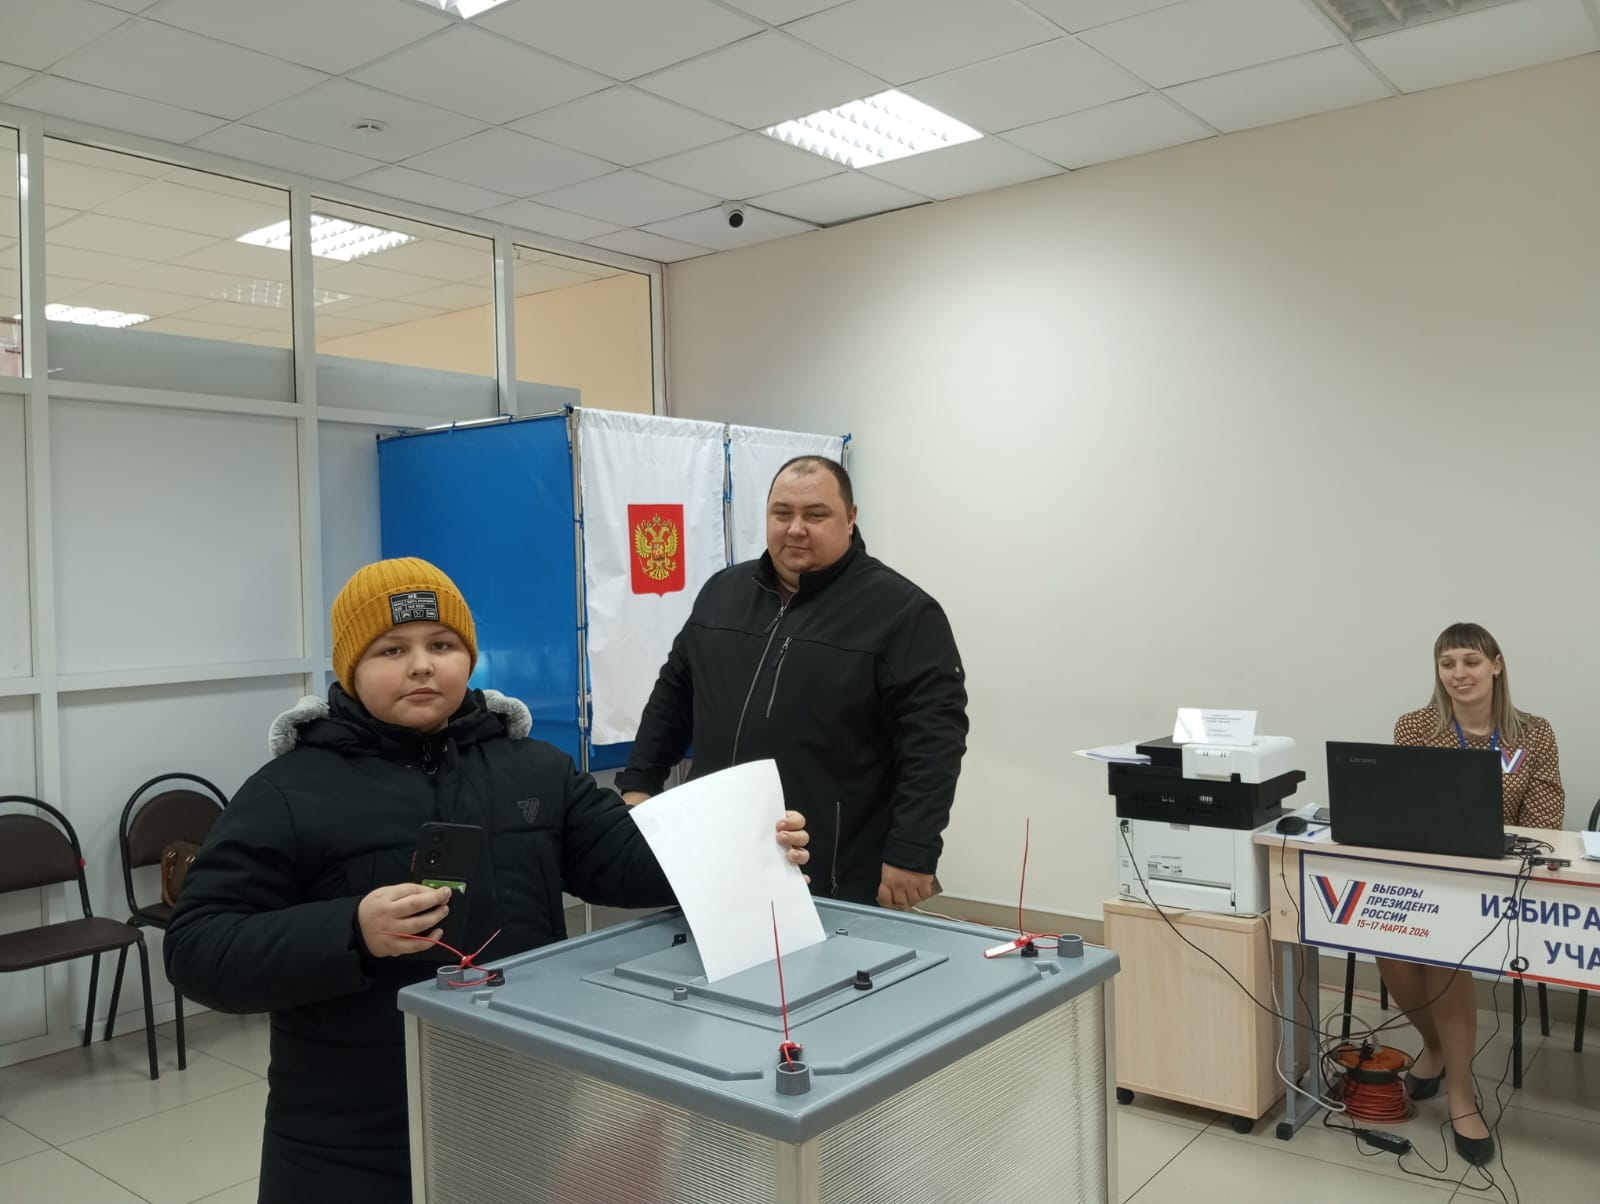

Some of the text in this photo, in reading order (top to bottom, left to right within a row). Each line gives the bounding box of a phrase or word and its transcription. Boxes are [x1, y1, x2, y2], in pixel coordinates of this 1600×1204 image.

[1372, 883, 1424, 899] ВЫБОРЫ
[1366, 895, 1440, 914] ПРЕЗИДЕНТА
[1360, 907, 1408, 923] РОССИИ
[1380, 923, 1408, 935] МАРТА
[1408, 927, 1430, 938] 2024
